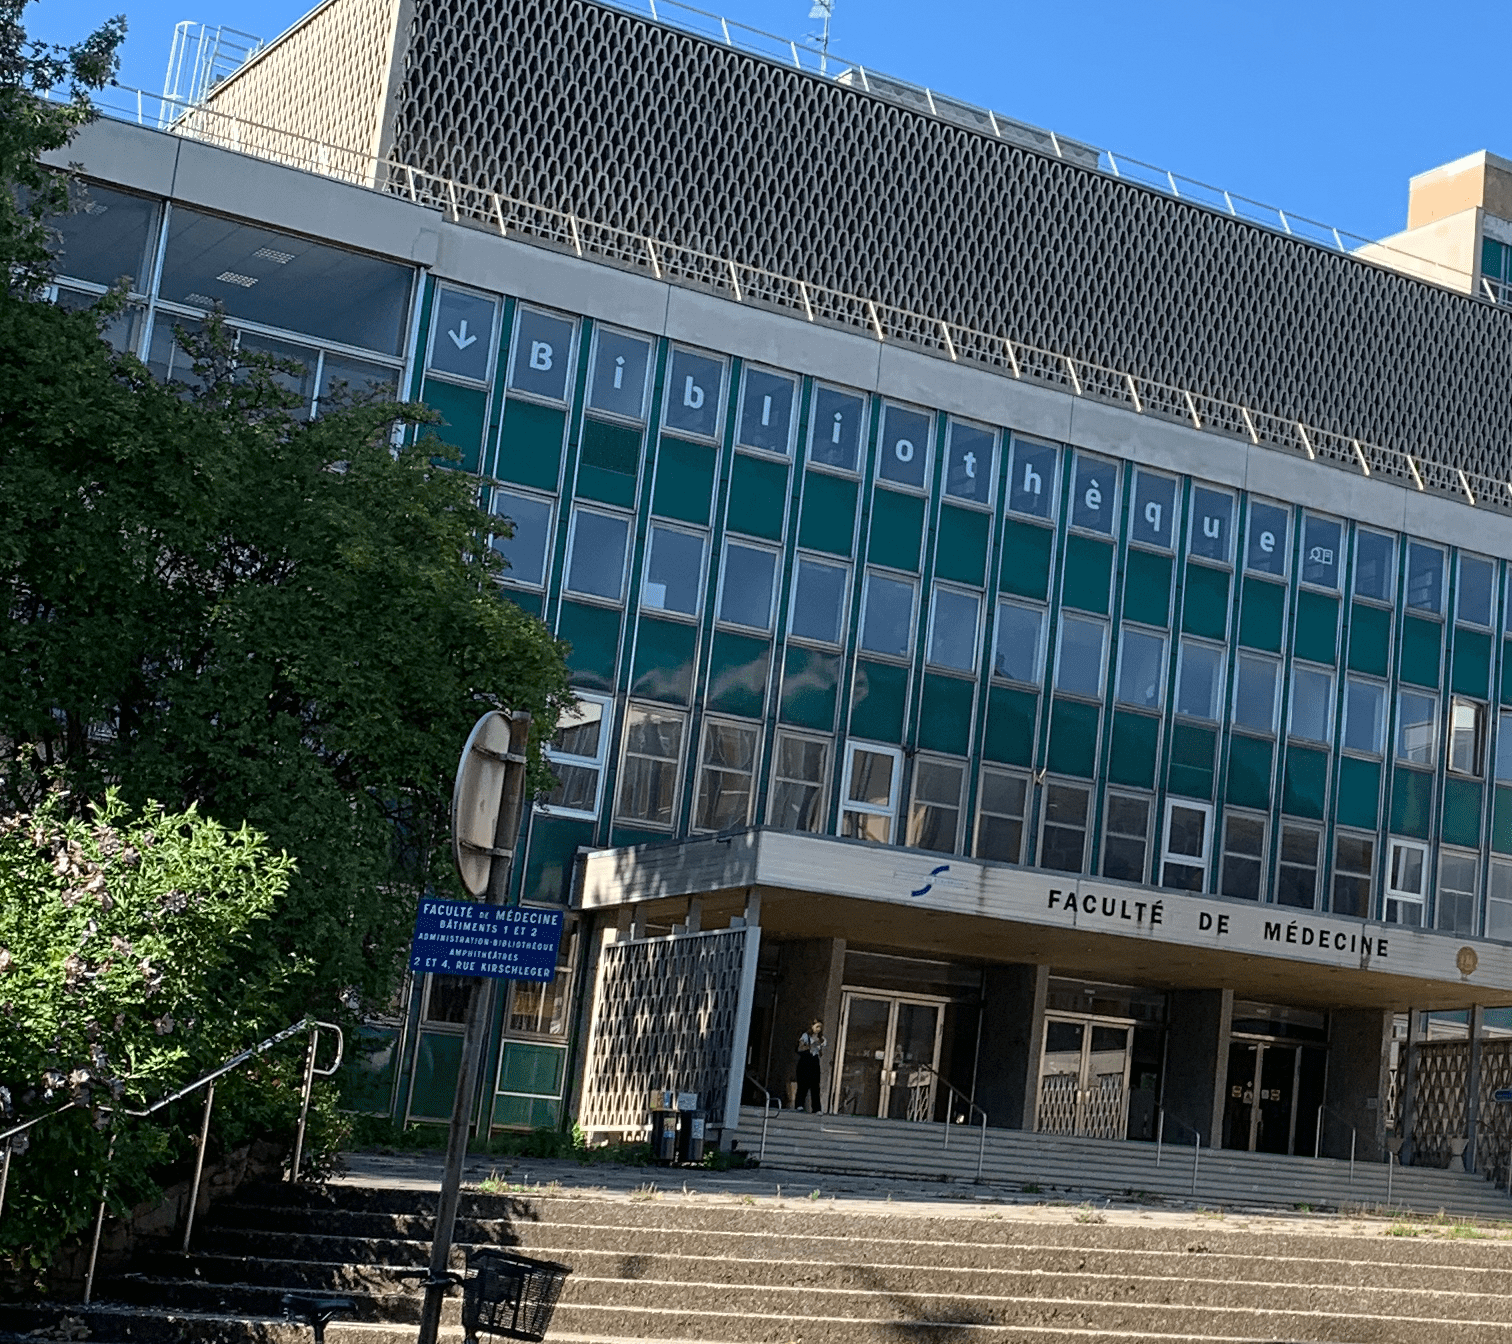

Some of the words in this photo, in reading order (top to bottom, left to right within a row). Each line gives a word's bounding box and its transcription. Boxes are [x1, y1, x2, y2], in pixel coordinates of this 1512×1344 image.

[423, 903, 473, 918] FACULTÉ
[479, 911, 489, 919] DE
[495, 908, 558, 926] MÉDECINE
[1048, 889, 1164, 925] FACULTÉ
[1198, 911, 1230, 935] DE
[1264, 919, 1390, 958] MÉDECINE
[439, 919, 498, 933] BÂTIMENTS
[503, 925, 508, 934] 1
[513, 926, 526, 935] ET
[530, 927, 538, 937] 2
[413, 957, 421, 966] 2
[425, 957, 437, 967] ET
[455, 960, 476, 971] RUE
[480, 962, 551, 978] KIRSCHLEGER
